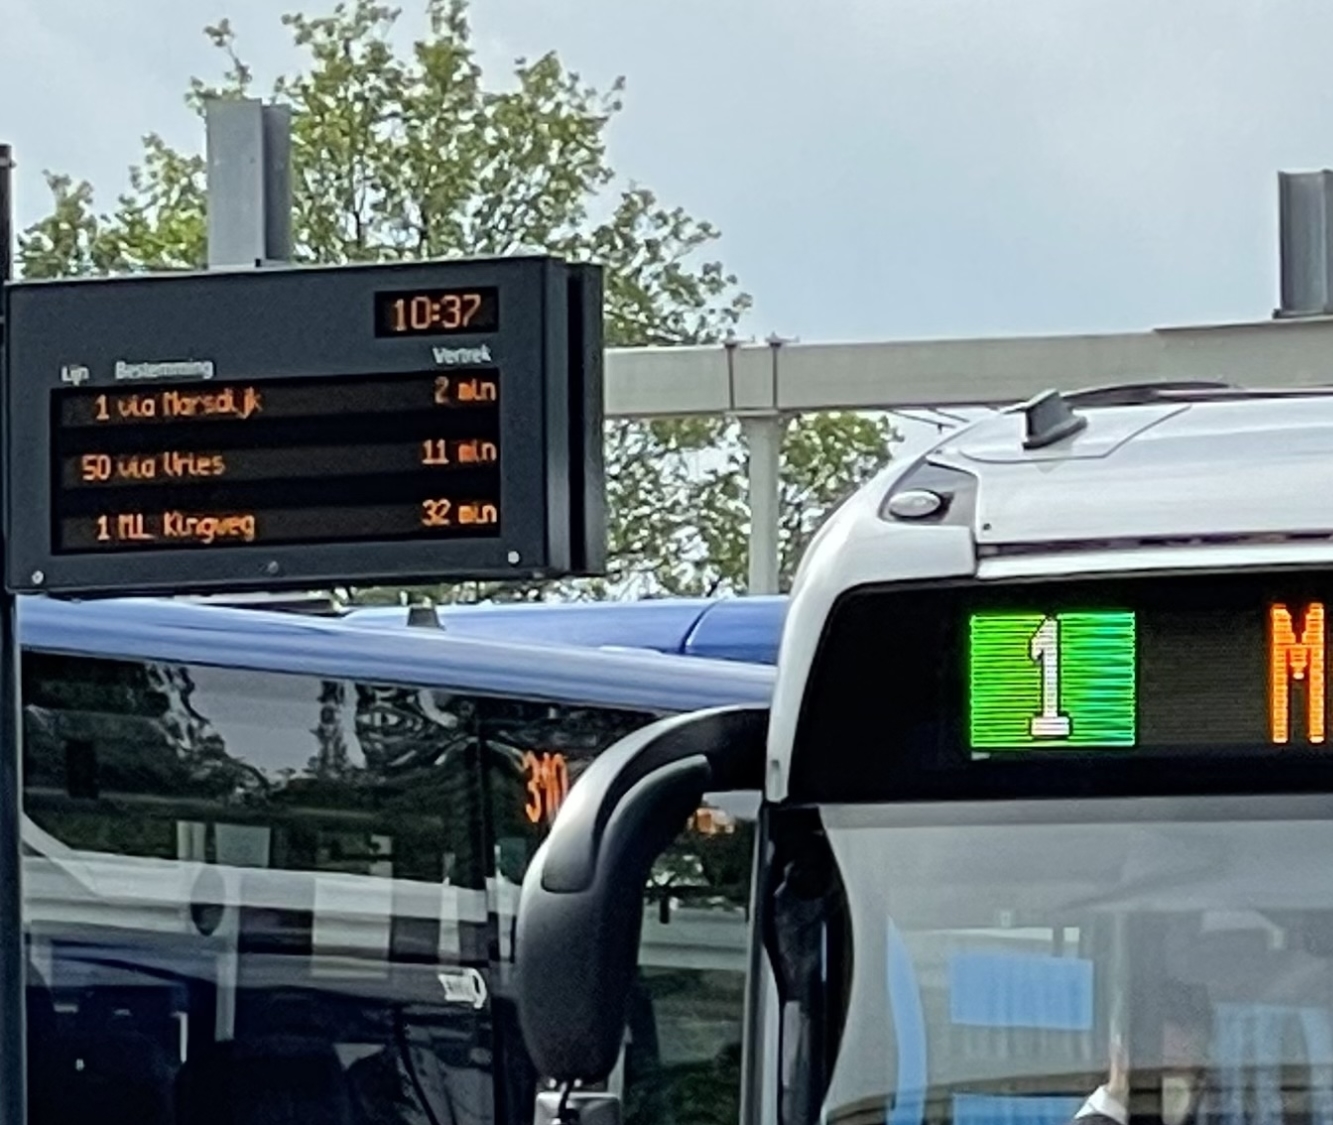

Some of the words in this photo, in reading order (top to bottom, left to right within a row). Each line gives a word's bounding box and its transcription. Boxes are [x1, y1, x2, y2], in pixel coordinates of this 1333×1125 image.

[394, 293, 481, 332] 10:37
[114, 360, 214, 381] Bestemming
[432, 344, 491, 364] Vertrek
[95, 394, 110, 421] 1
[118, 394, 156, 418] via
[434, 375, 449, 404] 2
[457, 378, 496, 401] min
[82, 454, 111, 481] 50
[118, 454, 156, 478] via
[422, 438, 449, 465] 11
[457, 439, 497, 463] min
[97, 514, 110, 541] 1
[422, 498, 451, 527] 32
[457, 503, 497, 524] min
[1029, 614, 1071, 741] 1
